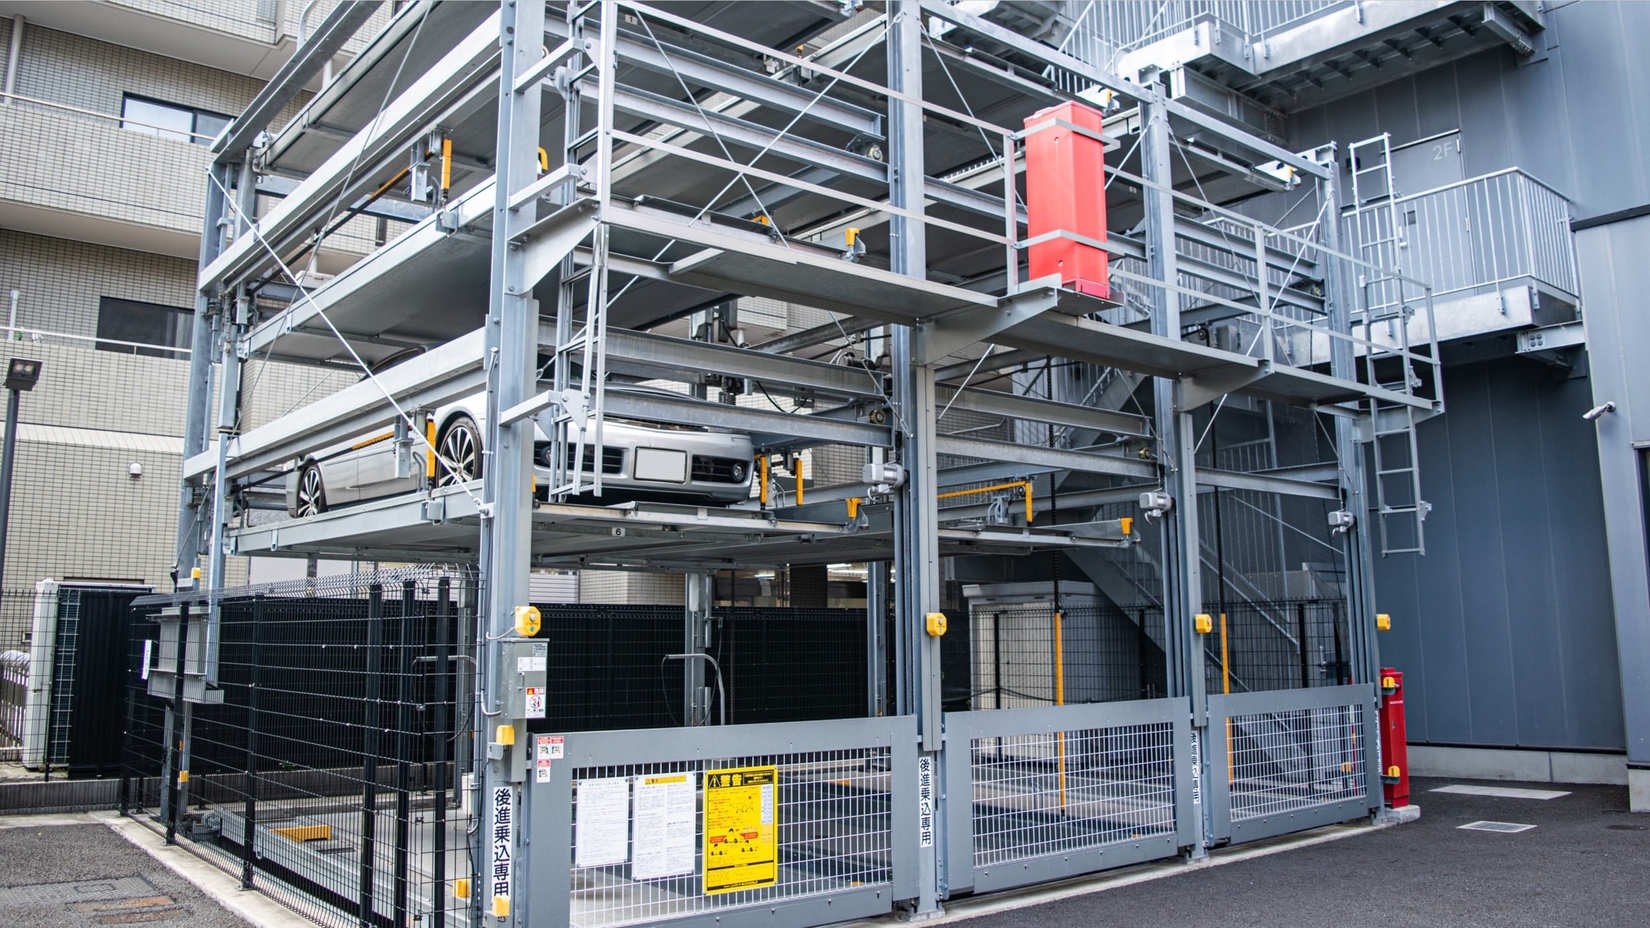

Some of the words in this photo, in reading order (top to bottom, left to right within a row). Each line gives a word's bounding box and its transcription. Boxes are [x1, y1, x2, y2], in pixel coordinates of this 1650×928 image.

[1432, 142, 1453, 160] 2F
[493, 788, 511, 896] 後進乗込専用
[920, 758, 931, 844] 後進乗込専用
